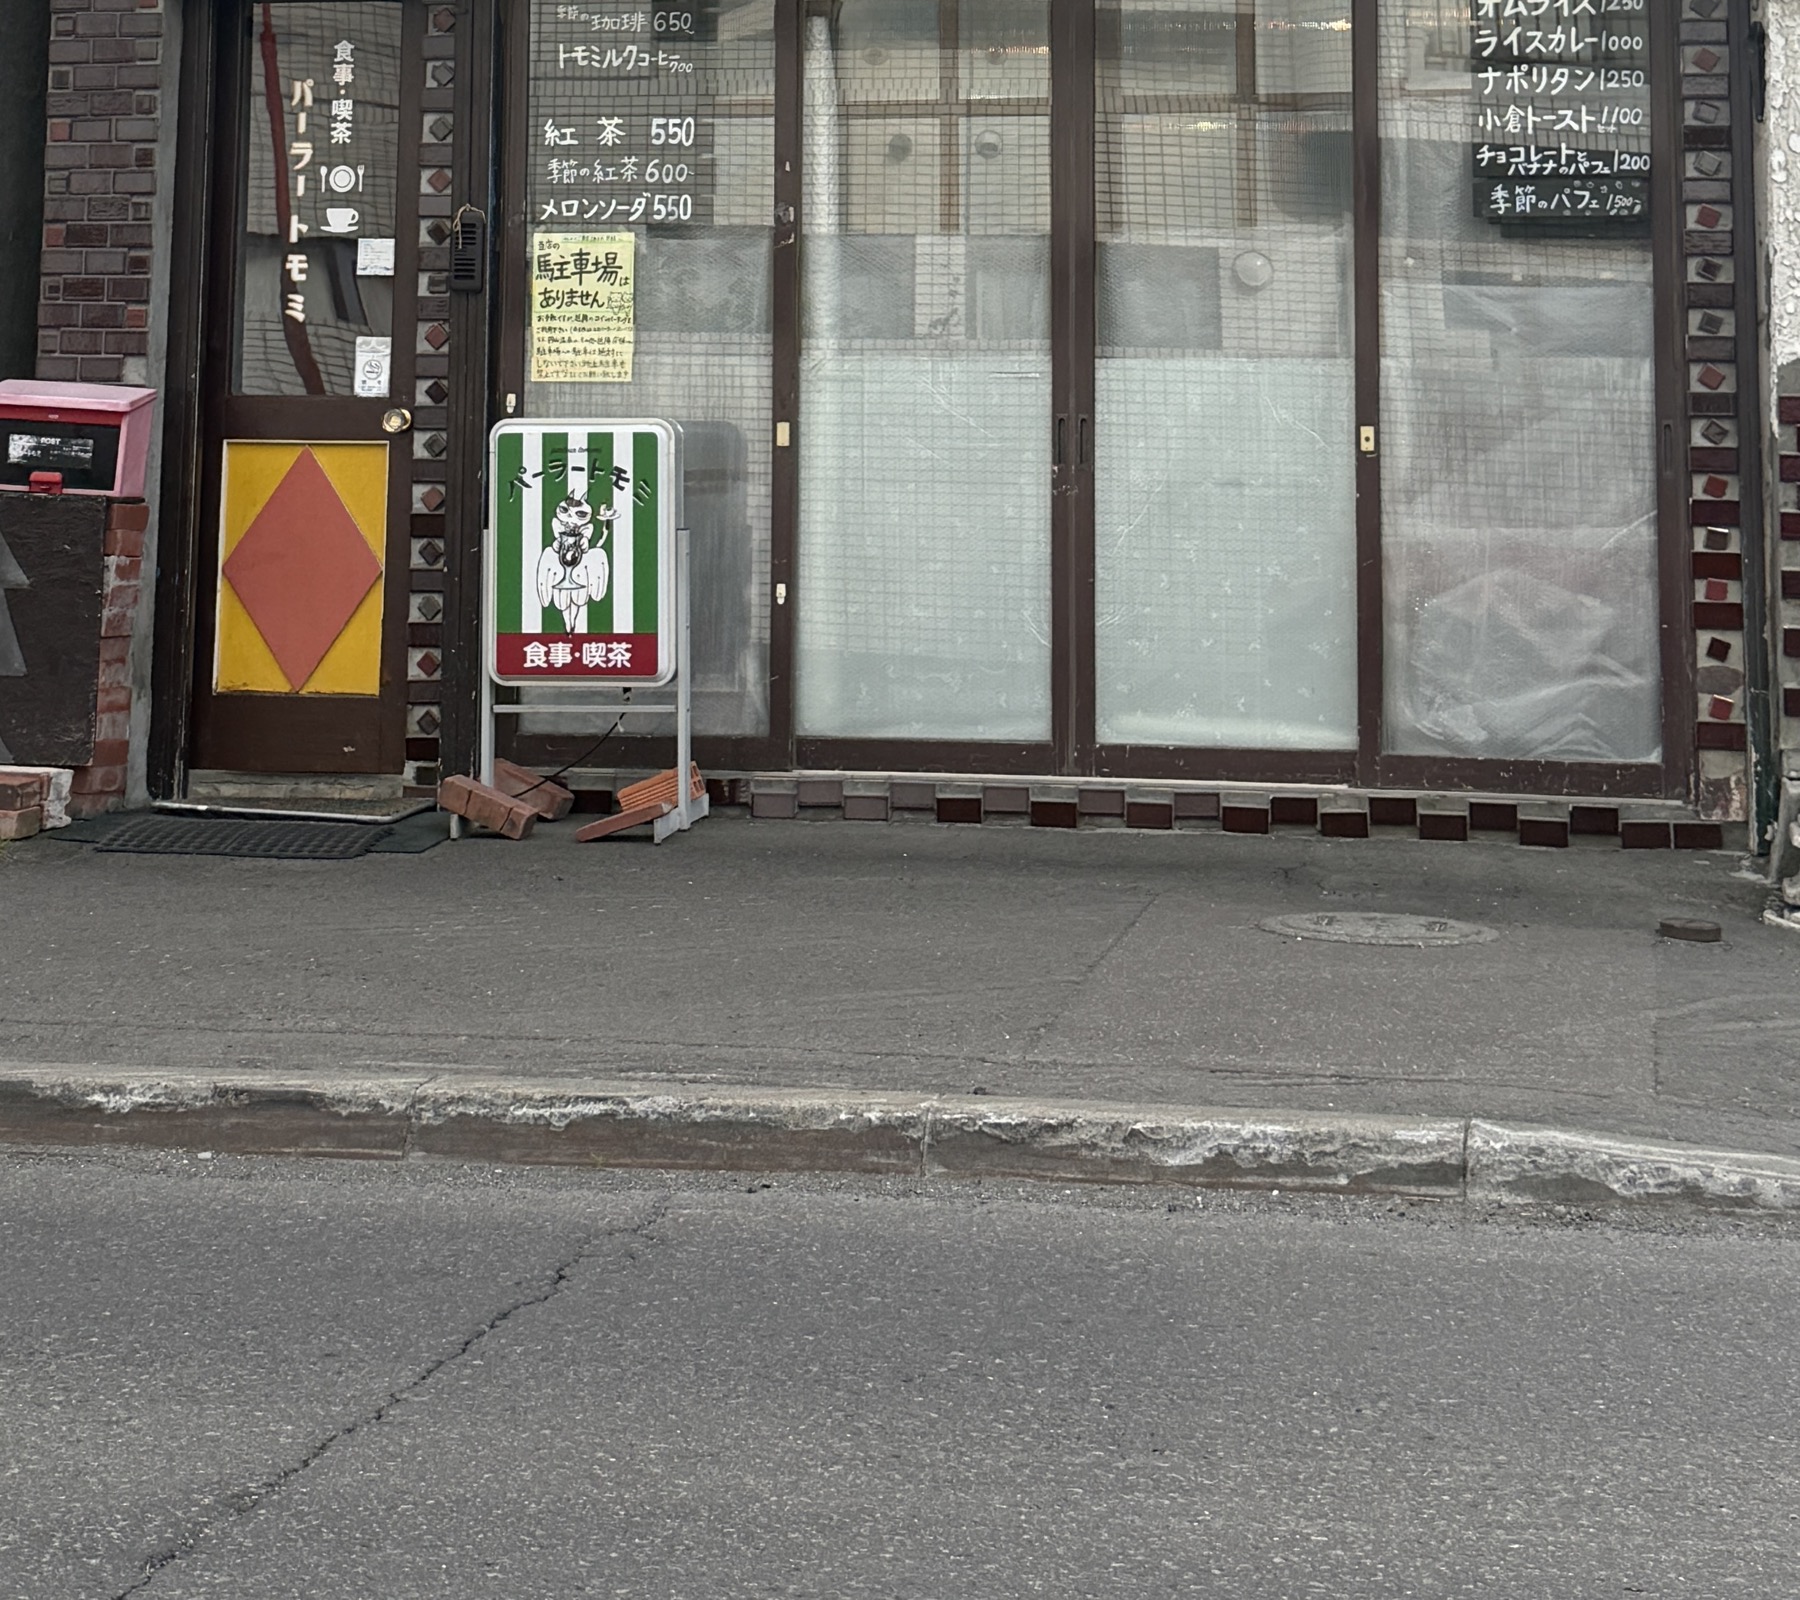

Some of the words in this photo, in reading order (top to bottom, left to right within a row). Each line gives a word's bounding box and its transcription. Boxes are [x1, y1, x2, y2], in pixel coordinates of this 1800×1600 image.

[557, 5, 648, 32] 季節の珈琲
[1475, 25, 1598, 57] ライスカレー
[1601, 30, 1643, 51] 1000
[669, 61, 693, 73] 700
[1477, 64, 1595, 95] ナポリタン
[1600, 68, 1644, 90] 1250
[330, 40, 355, 144] 食事・喫茶
[651, 117, 694, 146] 550
[1478, 104, 1596, 134] 小倉トースト
[1602, 105, 1643, 125] 1100
[547, 156, 638, 184] 季節の紅茶
[1476, 142, 1587, 167] チョコレートと
[1613, 149, 1650, 173] 1200
[1508, 160, 1611, 176] バナナのパフェ
[285, 78, 315, 323] パーラートモミ
[540, 192, 651, 221] メロンソーダ
[653, 194, 692, 221] 550
[1490, 183, 1600, 215] 季節のパフェ
[536, 247, 630, 287] 駐車場は
[538, 287, 605, 309] ありません
[508, 458, 652, 506] パーラートモミ
[523, 642, 632, 668] 食事・喫茶
